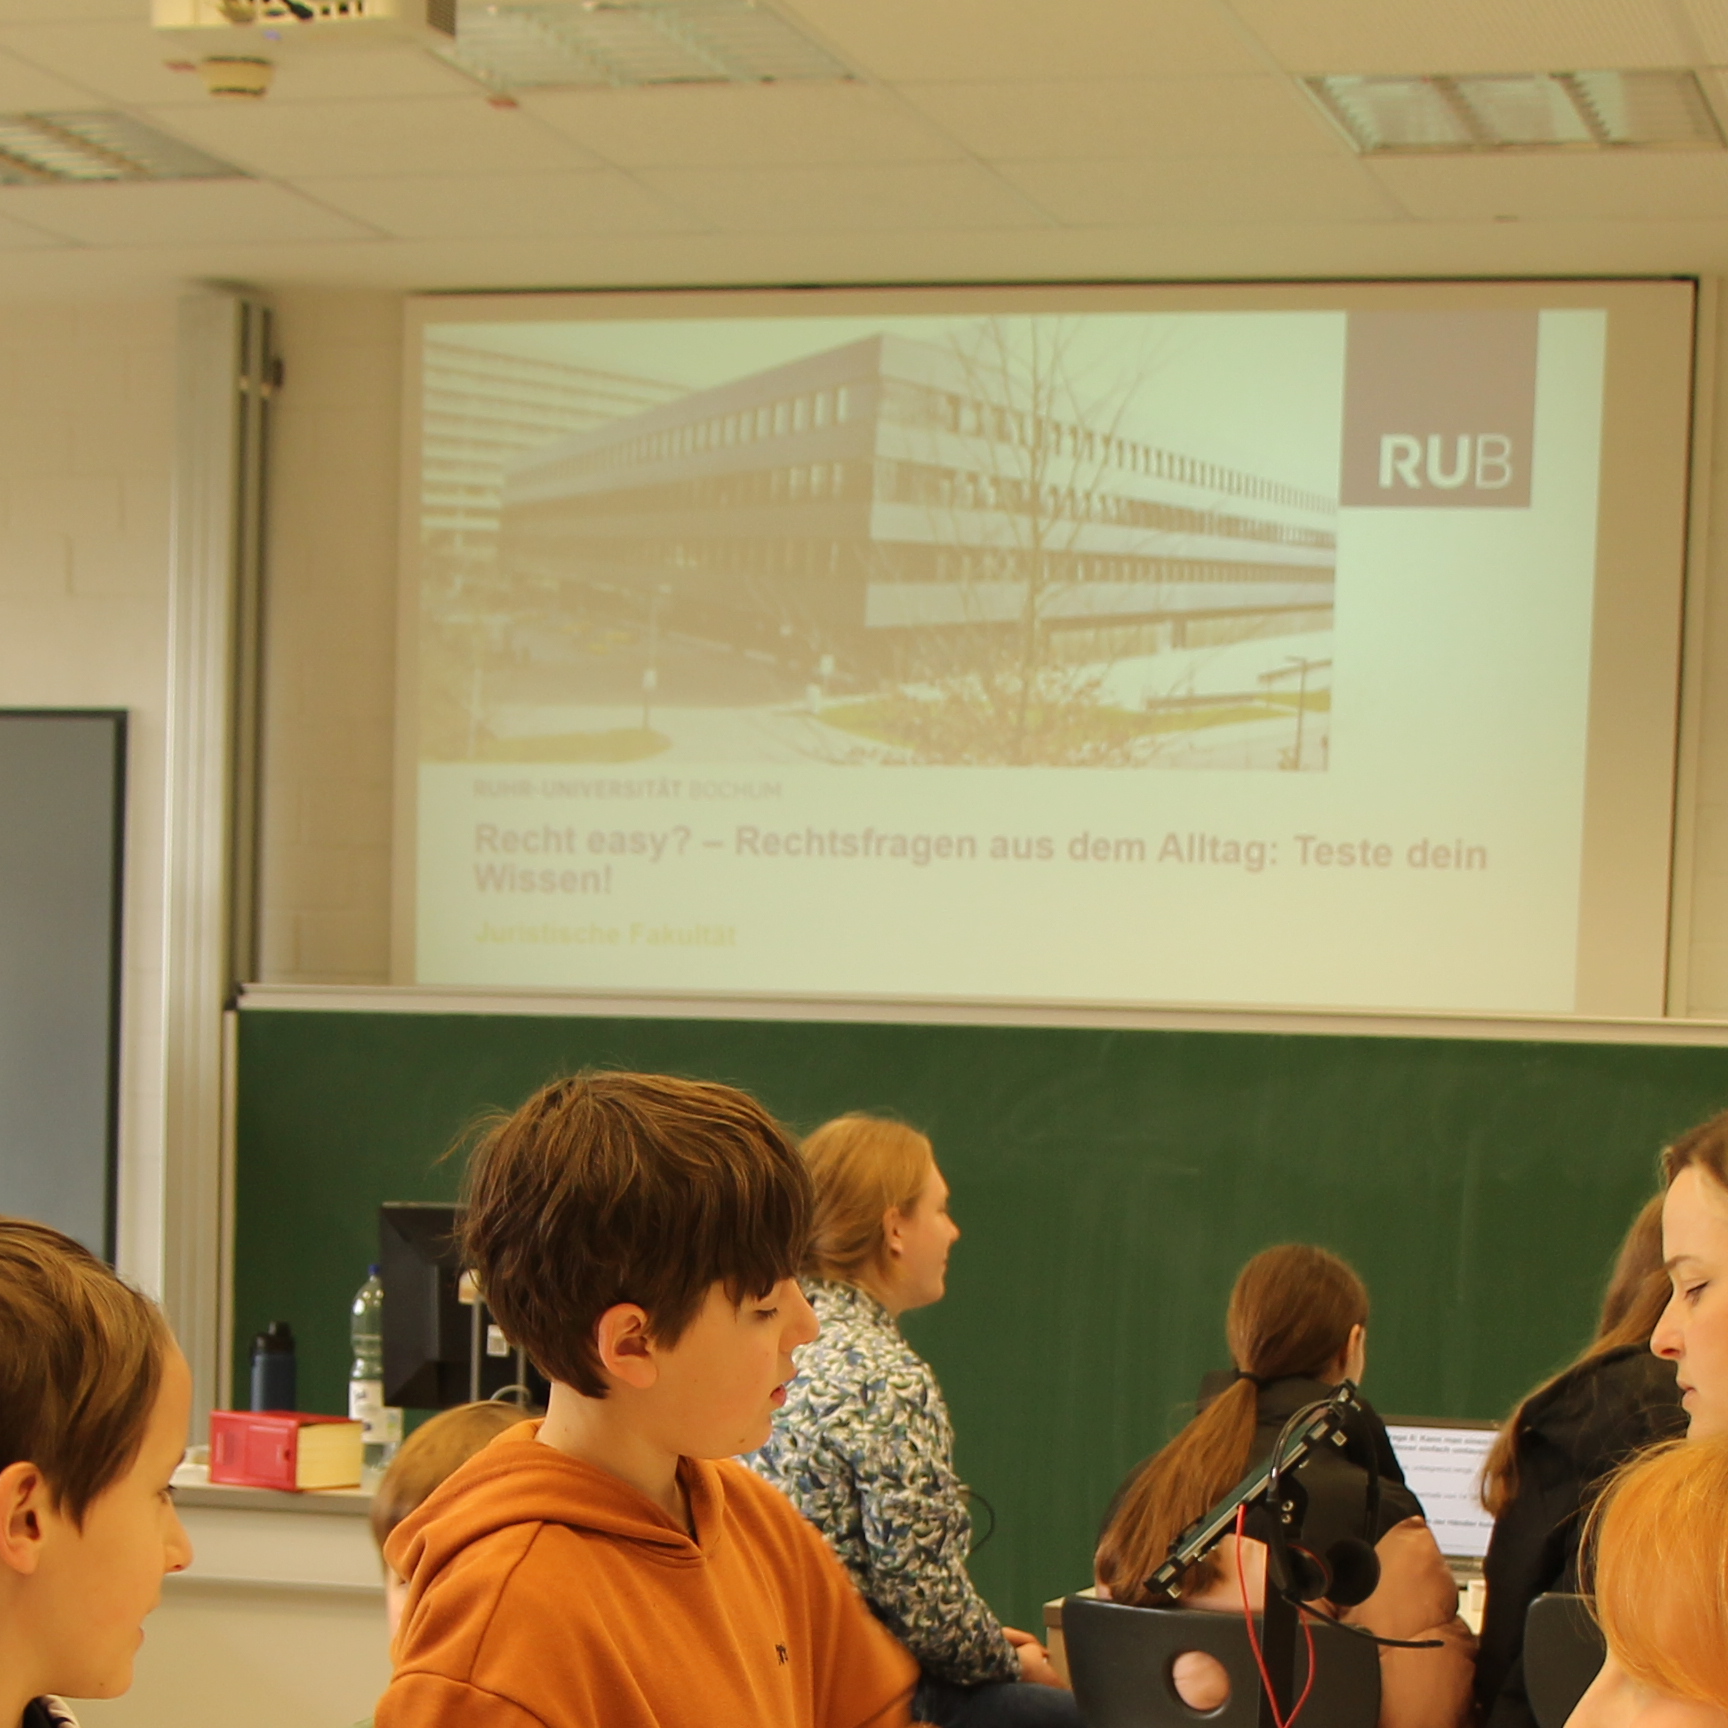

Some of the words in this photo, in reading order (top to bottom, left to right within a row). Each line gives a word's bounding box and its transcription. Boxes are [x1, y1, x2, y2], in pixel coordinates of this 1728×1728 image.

[1378, 433, 1513, 490] RUB
[473, 777, 682, 799] RUHR-UNIVERSITÄT
[688, 782, 782, 799] BOCHUM
[474, 824, 577, 856] Recht
[588, 825, 692, 863] easy?
[735, 826, 974, 867] Rechtsfragen
[989, 834, 1055, 860] aus
[1068, 831, 1146, 862] dem
[1158, 831, 1277, 874] Alltag:
[1294, 834, 1393, 869] Teste
[1407, 837, 1489, 871] dein
[473, 864, 613, 895] Wissen!
[475, 922, 620, 946] Juristische
[630, 921, 737, 947] Fakultät
